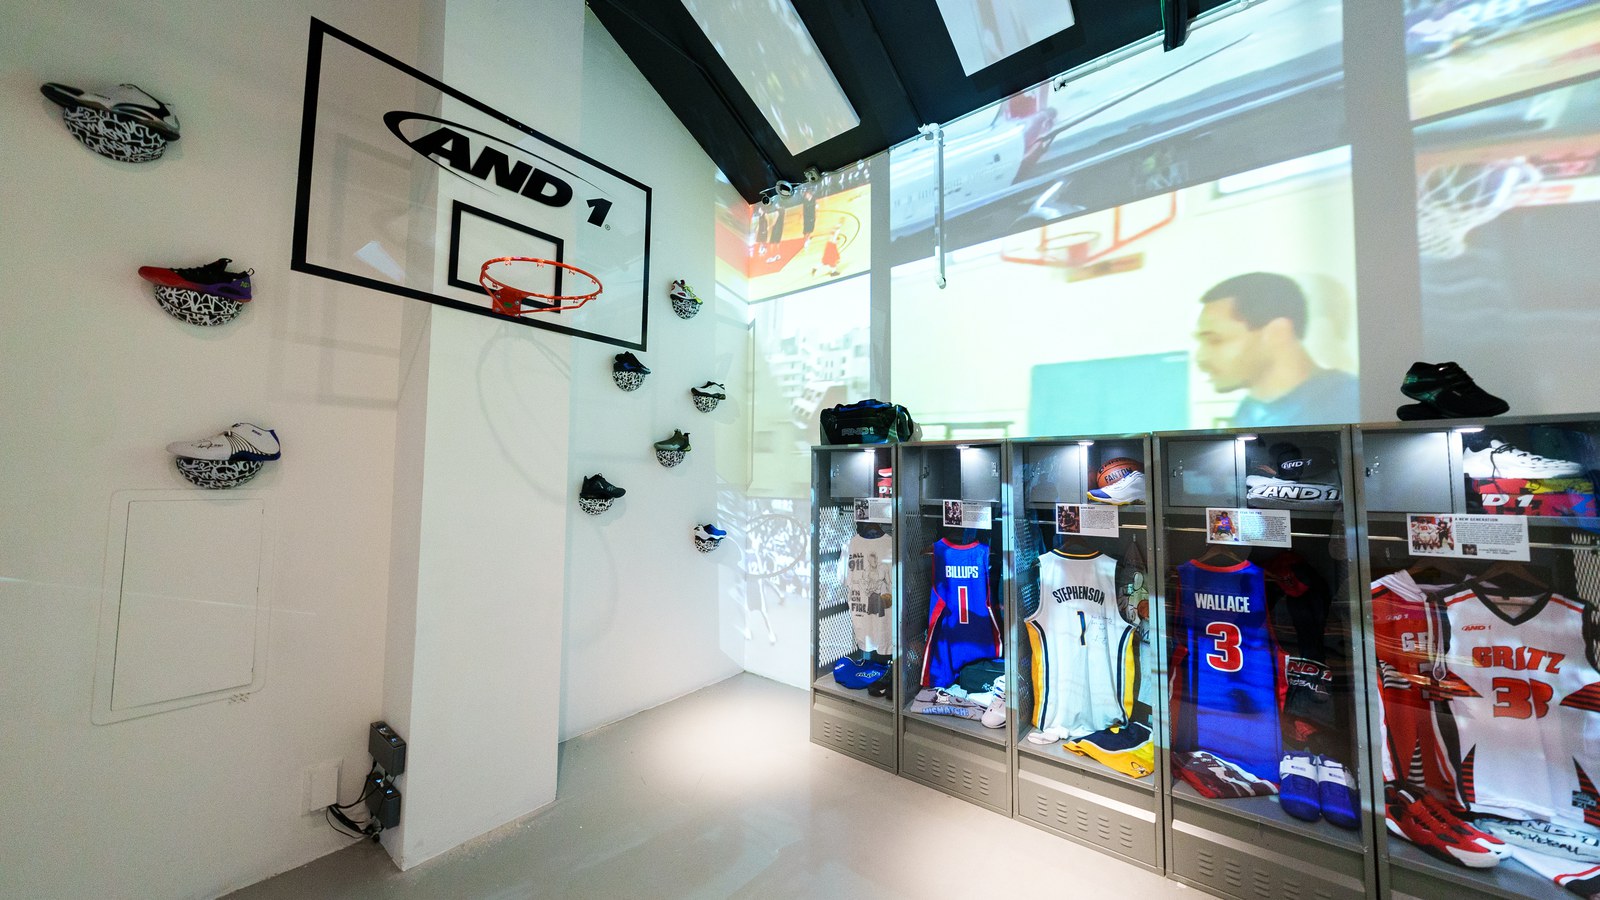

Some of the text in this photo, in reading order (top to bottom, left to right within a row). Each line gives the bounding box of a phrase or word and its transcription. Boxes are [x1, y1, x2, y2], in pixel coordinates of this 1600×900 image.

[410, 126, 613, 228] AND 1
[1261, 485, 1340, 500] AND 1
[1482, 493, 1535, 507] D 1
[945, 565, 979, 579] BILLUPS
[957, 586, 969, 625] 1
[1052, 585, 1106, 606] STEPHENSON
[1194, 592, 1251, 613] WALLACE
[1076, 610, 1087, 646] 1
[1205, 621, 1244, 673] 3
[1472, 646, 1567, 675] GRITZ
